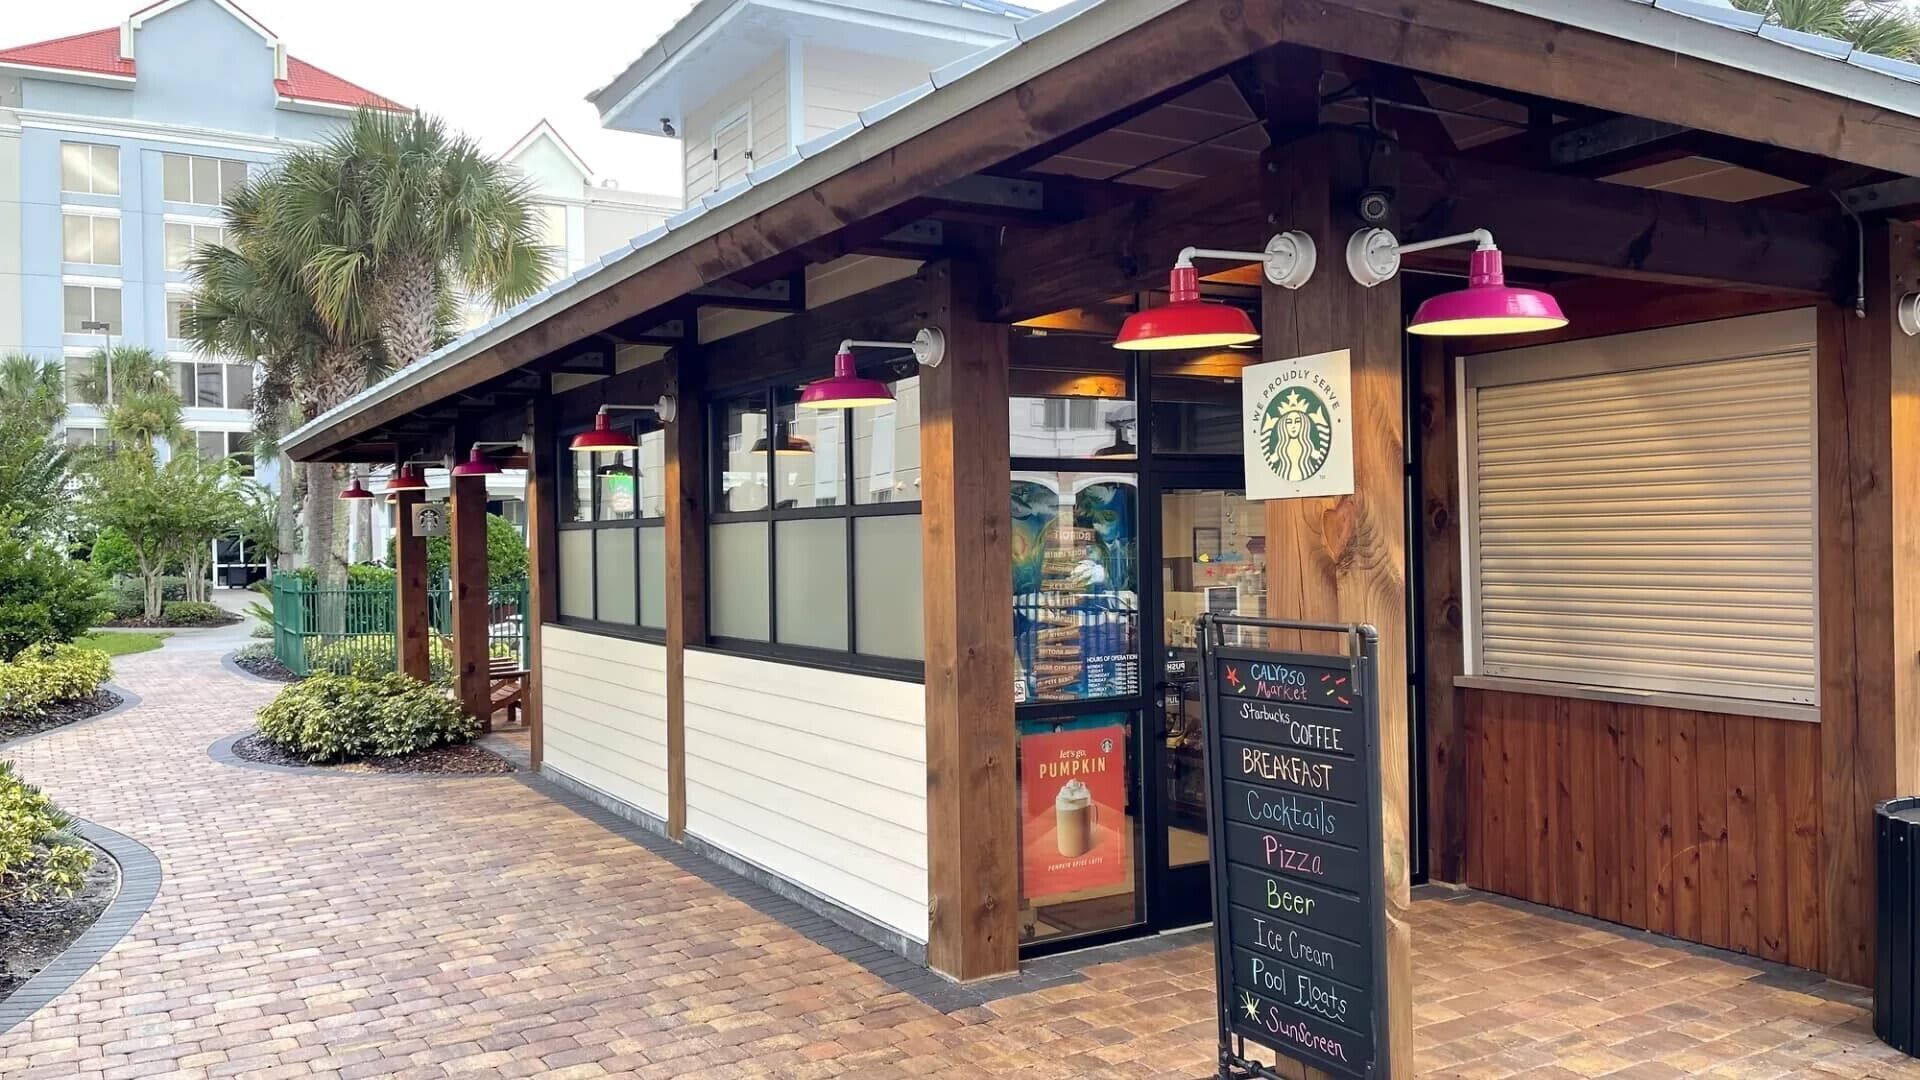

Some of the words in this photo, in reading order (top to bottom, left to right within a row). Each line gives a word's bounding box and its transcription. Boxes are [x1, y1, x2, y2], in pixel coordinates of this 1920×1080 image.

[1253, 402, 1264, 422] WE
[1263, 370, 1310, 399] PROUDLY
[1313, 374, 1340, 410] SERVE
[1251, 664, 1305, 685] CALYPSO
[1256, 681, 1307, 700] Market
[1240, 703, 1290, 724] Starbucks
[1290, 721, 1343, 751] COFFEE
[1040, 757, 1105, 778] PUMPKIN
[1243, 748, 1333, 791] BREAKFAST
[1247, 790, 1336, 836] Cocktails
[1262, 835, 1324, 875] Pizza
[1267, 879, 1316, 916] Beer
[1253, 917, 1283, 952] Ice
[1288, 930, 1334, 970] Cream
[1251, 958, 1287, 996] Pool
[1296, 975, 1348, 1014] Floats
